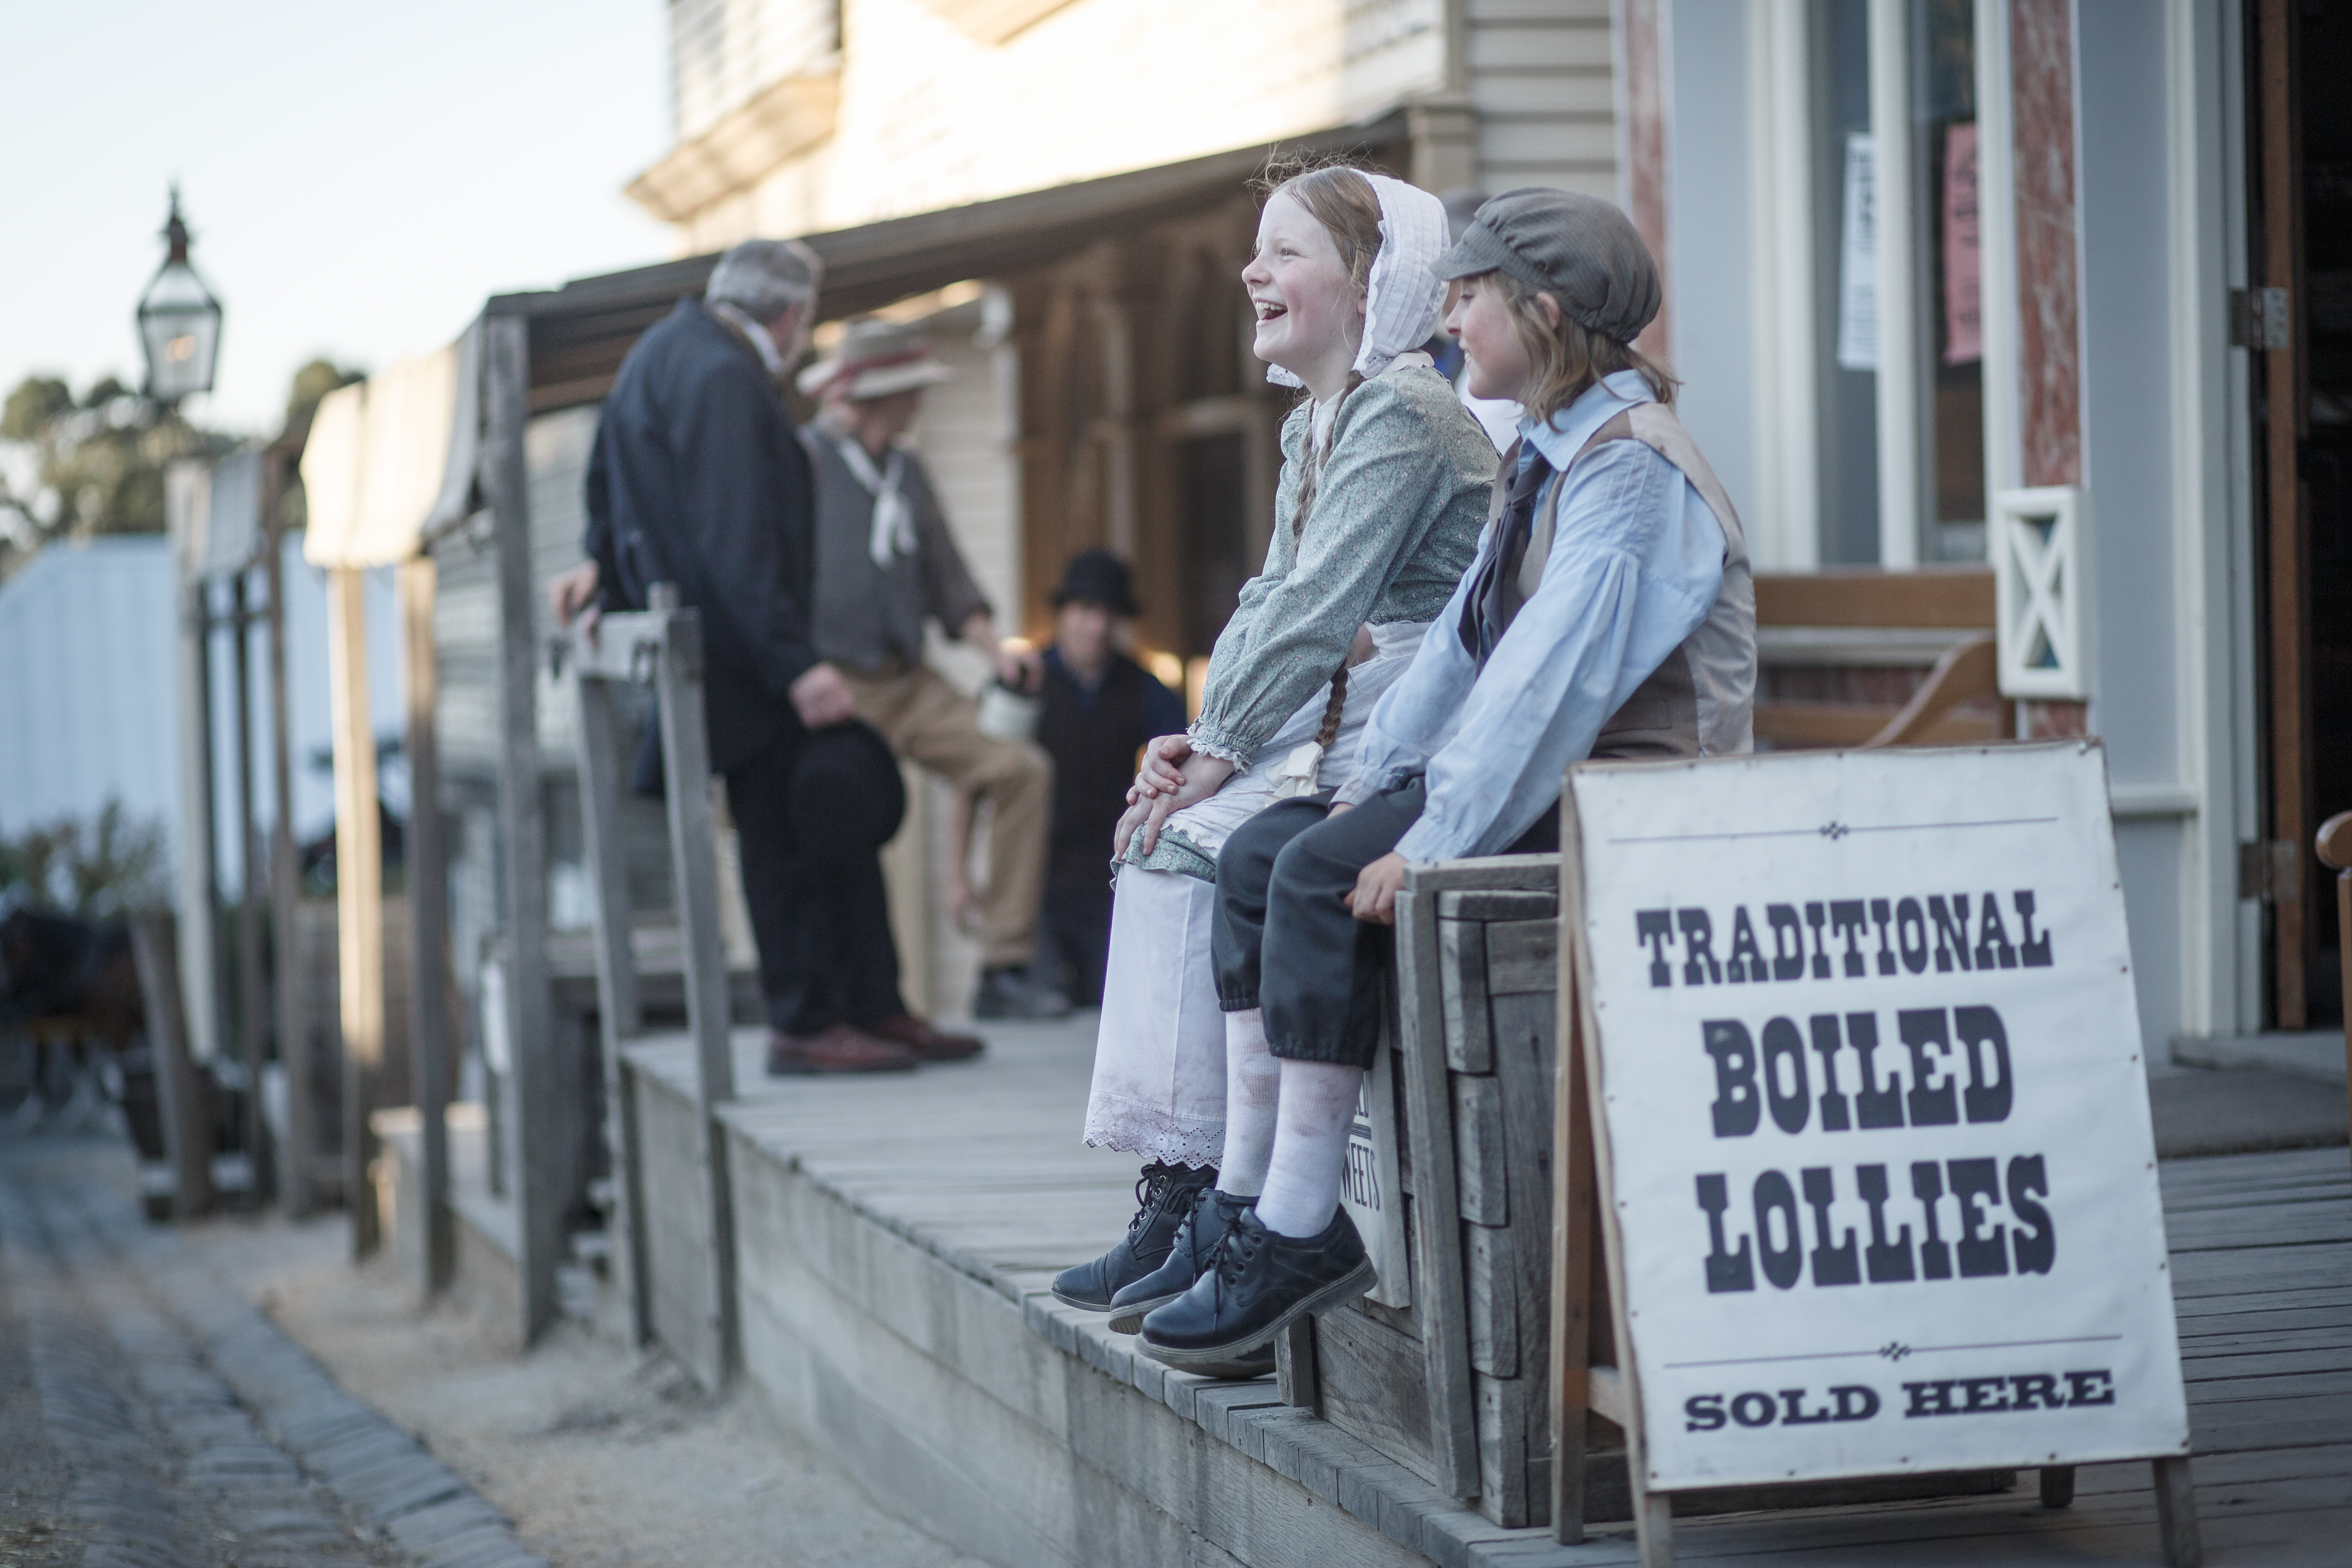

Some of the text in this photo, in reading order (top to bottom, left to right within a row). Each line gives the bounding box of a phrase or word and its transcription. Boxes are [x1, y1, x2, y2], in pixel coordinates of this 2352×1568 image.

[1636, 890, 2054, 987] TRADITIONAL
[1702, 1004, 2014, 1138] BOILED
[1341, 1142, 1380, 1212] WEETS
[1695, 1152, 2057, 1294] LOLLIES
[1684, 1368, 2117, 1433] SOLD HERE
